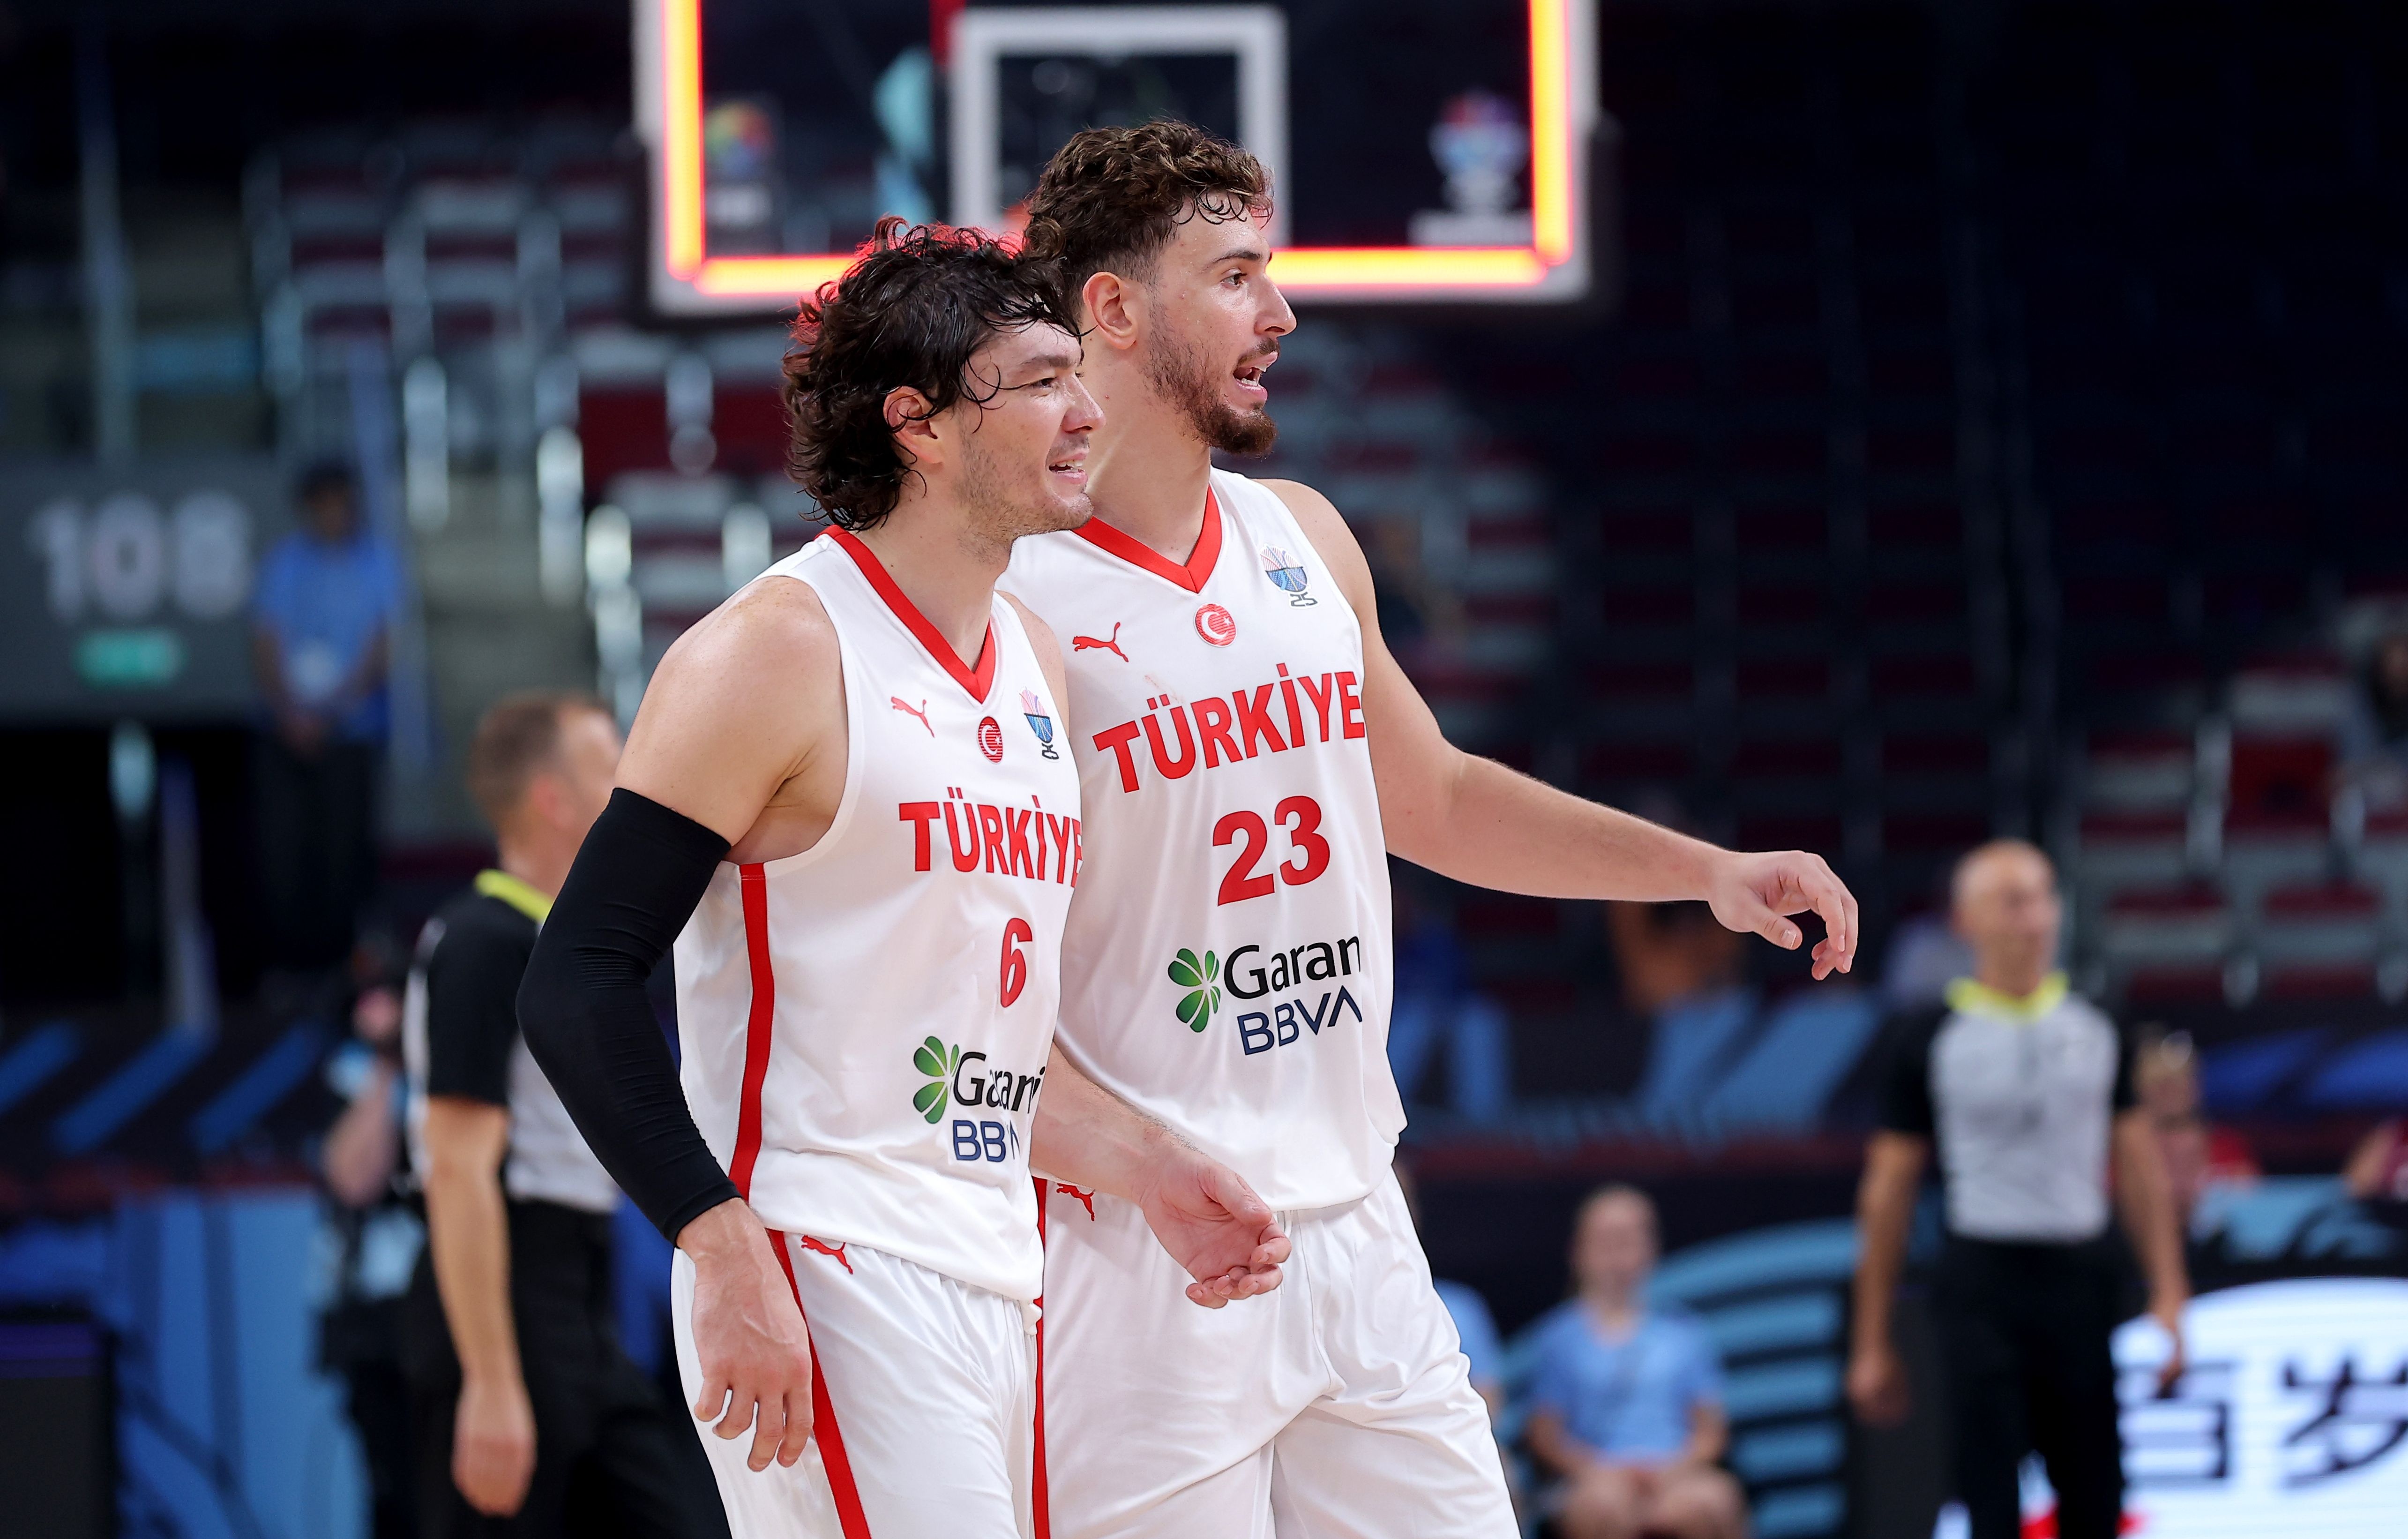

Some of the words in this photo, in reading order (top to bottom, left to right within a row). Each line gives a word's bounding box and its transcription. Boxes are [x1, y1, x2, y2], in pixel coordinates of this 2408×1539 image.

[1092, 662, 1365, 793] TÜRKİYE
[898, 786, 1082, 888] TÜRKİYE
[1212, 796, 1330, 907] 23
[1000, 917, 1032, 1008] 6
[1237, 985, 1362, 1055] BBVA
